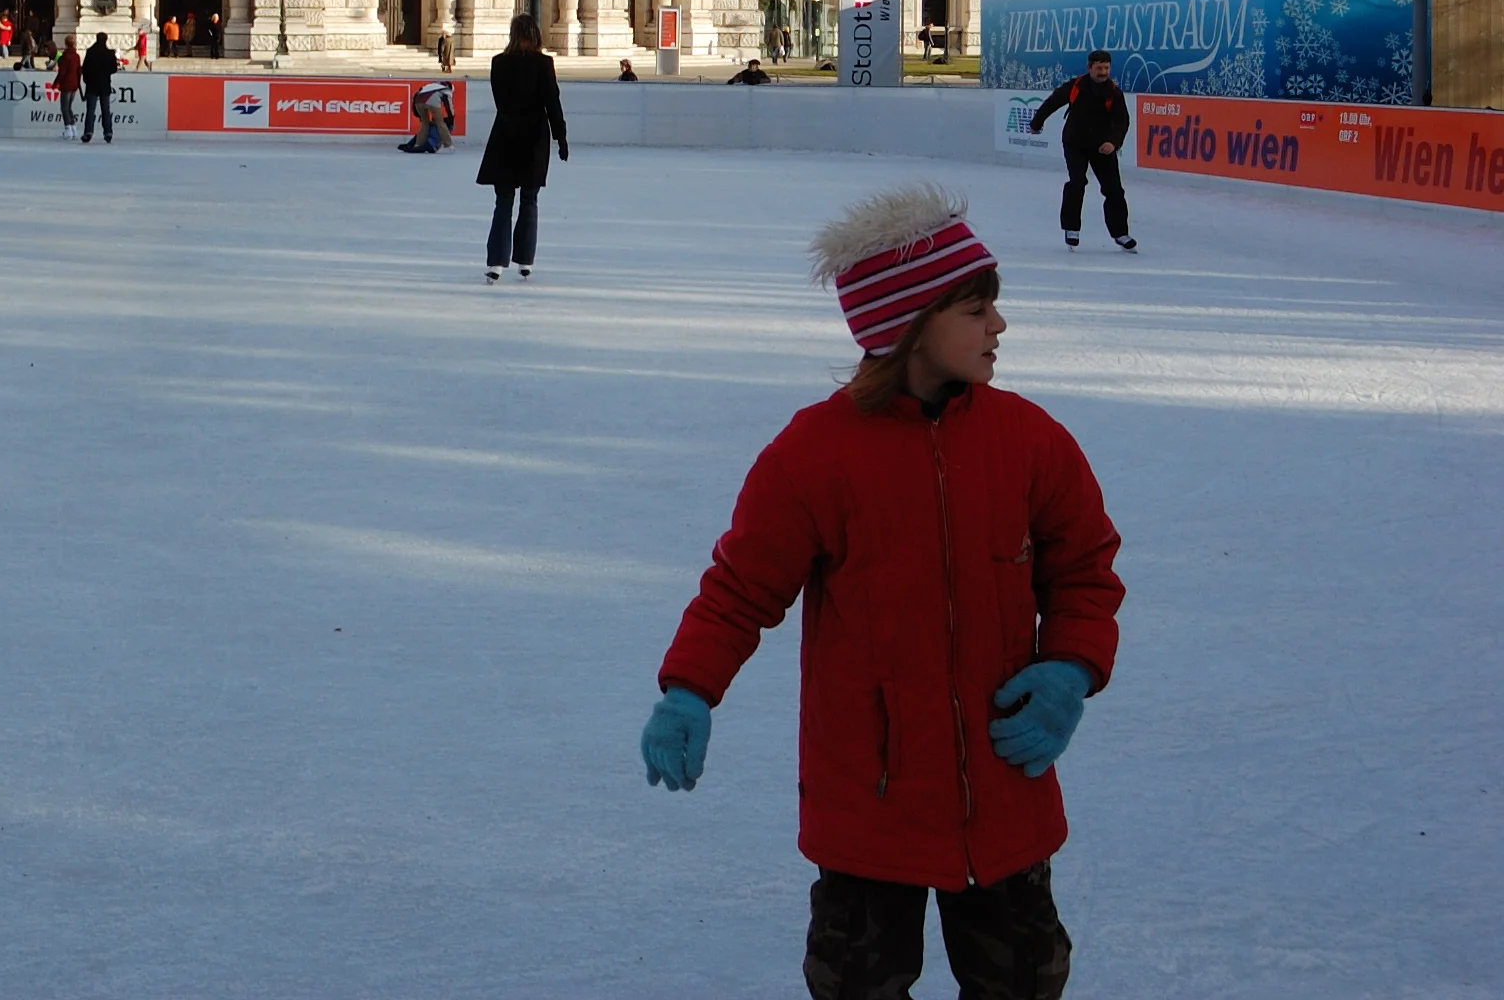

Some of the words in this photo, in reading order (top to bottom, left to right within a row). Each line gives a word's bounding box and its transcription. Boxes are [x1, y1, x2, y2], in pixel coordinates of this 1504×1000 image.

[1006, 6, 1098, 54] WIENER
[30, 110, 62, 123] Wien
[276, 99, 323, 113] WIEN
[326, 100, 404, 114] ENERGIE
[1146, 114, 1216, 162] radio
[1228, 118, 1300, 172] wien
[1353, 130, 1359, 144] 2
[1374, 124, 1454, 188] Wien
